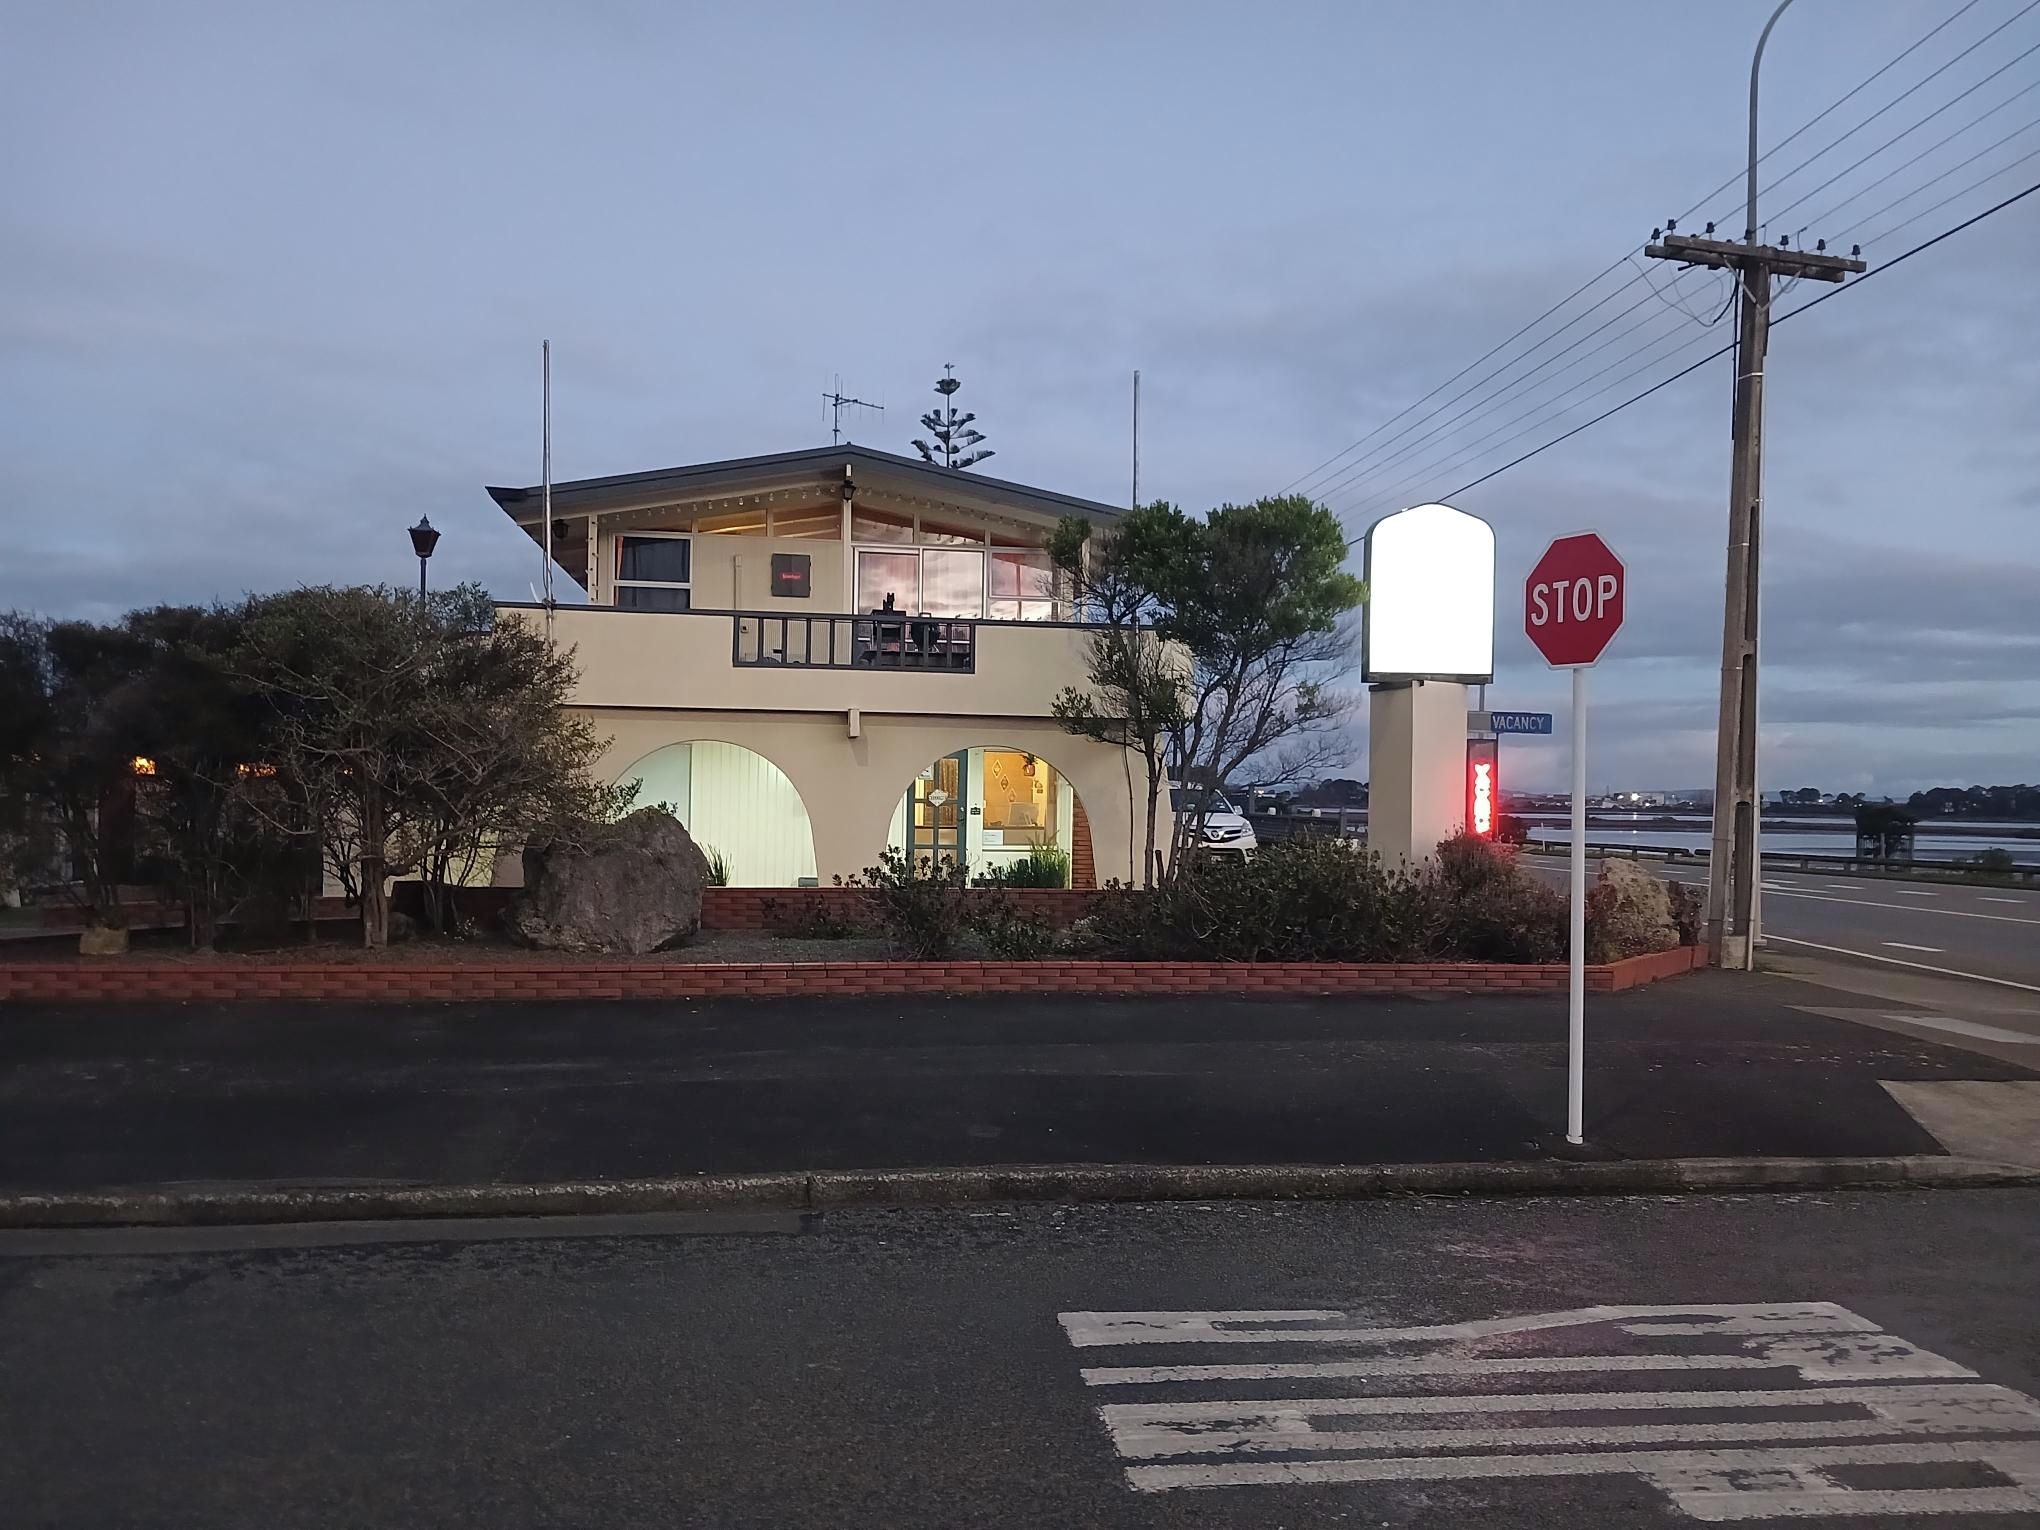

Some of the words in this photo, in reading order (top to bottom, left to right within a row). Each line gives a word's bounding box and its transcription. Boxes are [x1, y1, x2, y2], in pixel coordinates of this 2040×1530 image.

[1531, 574, 1618, 626] STOP
[1492, 715, 1545, 730] VACANCY
[1056, 1301, 2040, 1522] STOP
